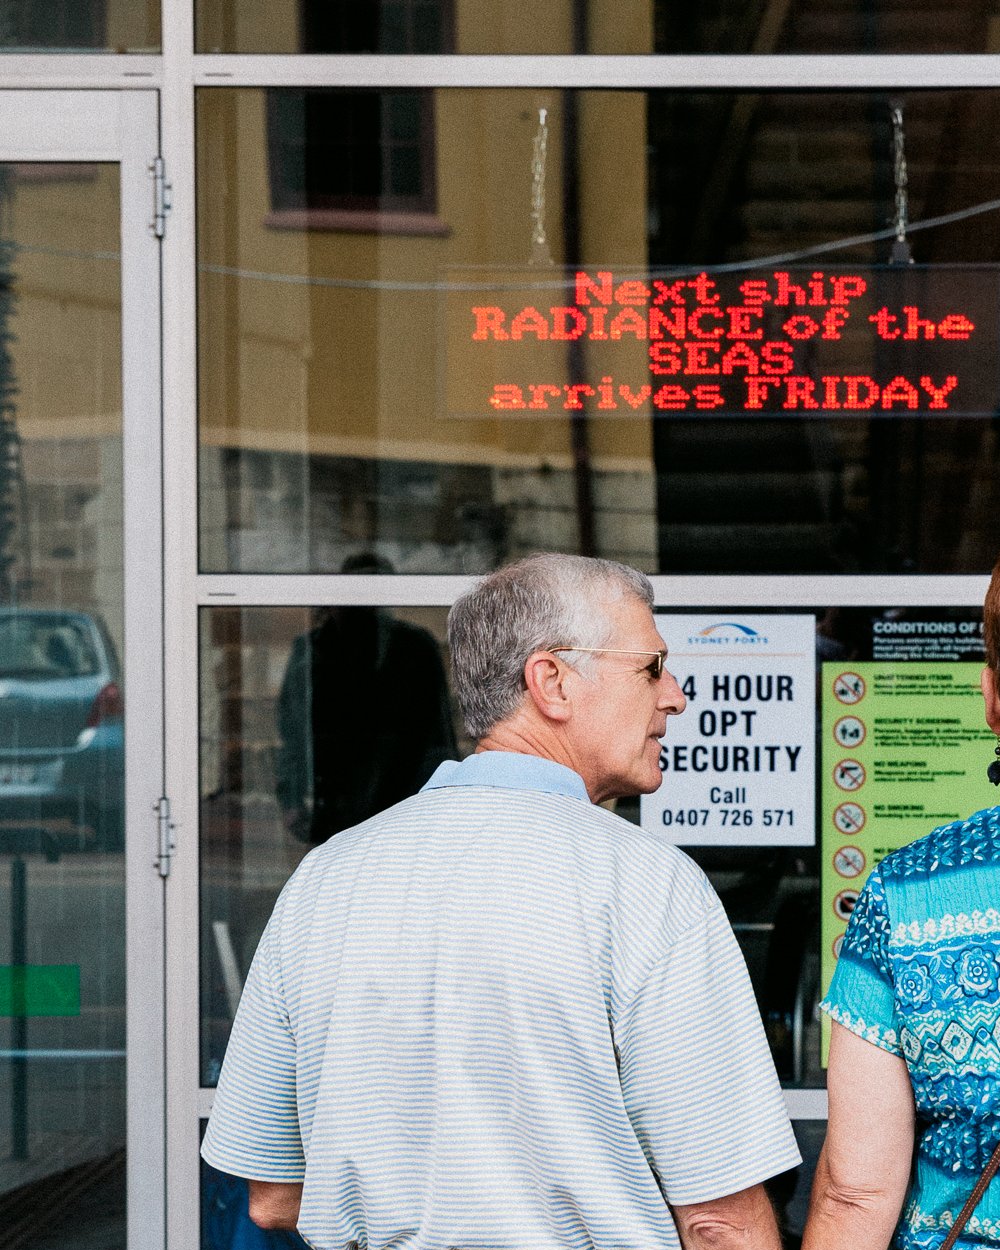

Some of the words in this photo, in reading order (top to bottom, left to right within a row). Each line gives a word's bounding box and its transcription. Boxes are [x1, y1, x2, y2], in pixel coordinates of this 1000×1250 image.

[575, 272, 720, 305] Next
[740, 272, 867, 305] ship
[472, 307, 764, 341] RADIANCE
[783, 307, 850, 341] of
[868, 307, 975, 341] the
[649, 342, 794, 375] SEAS
[490, 376, 725, 409] arrives
[744, 376, 959, 409] FRIDAY
[873, 622, 957, 634] CONDITIONS
[959, 622, 978, 634] OF
[713, 675, 794, 701] HOUR
[700, 710, 757, 737] OPT
[660, 746, 802, 772] SECURITY
[711, 787, 746, 804] Call
[662, 809, 710, 826] 0407
[719, 809, 753, 826] 726
[763, 809, 794, 826] 571
